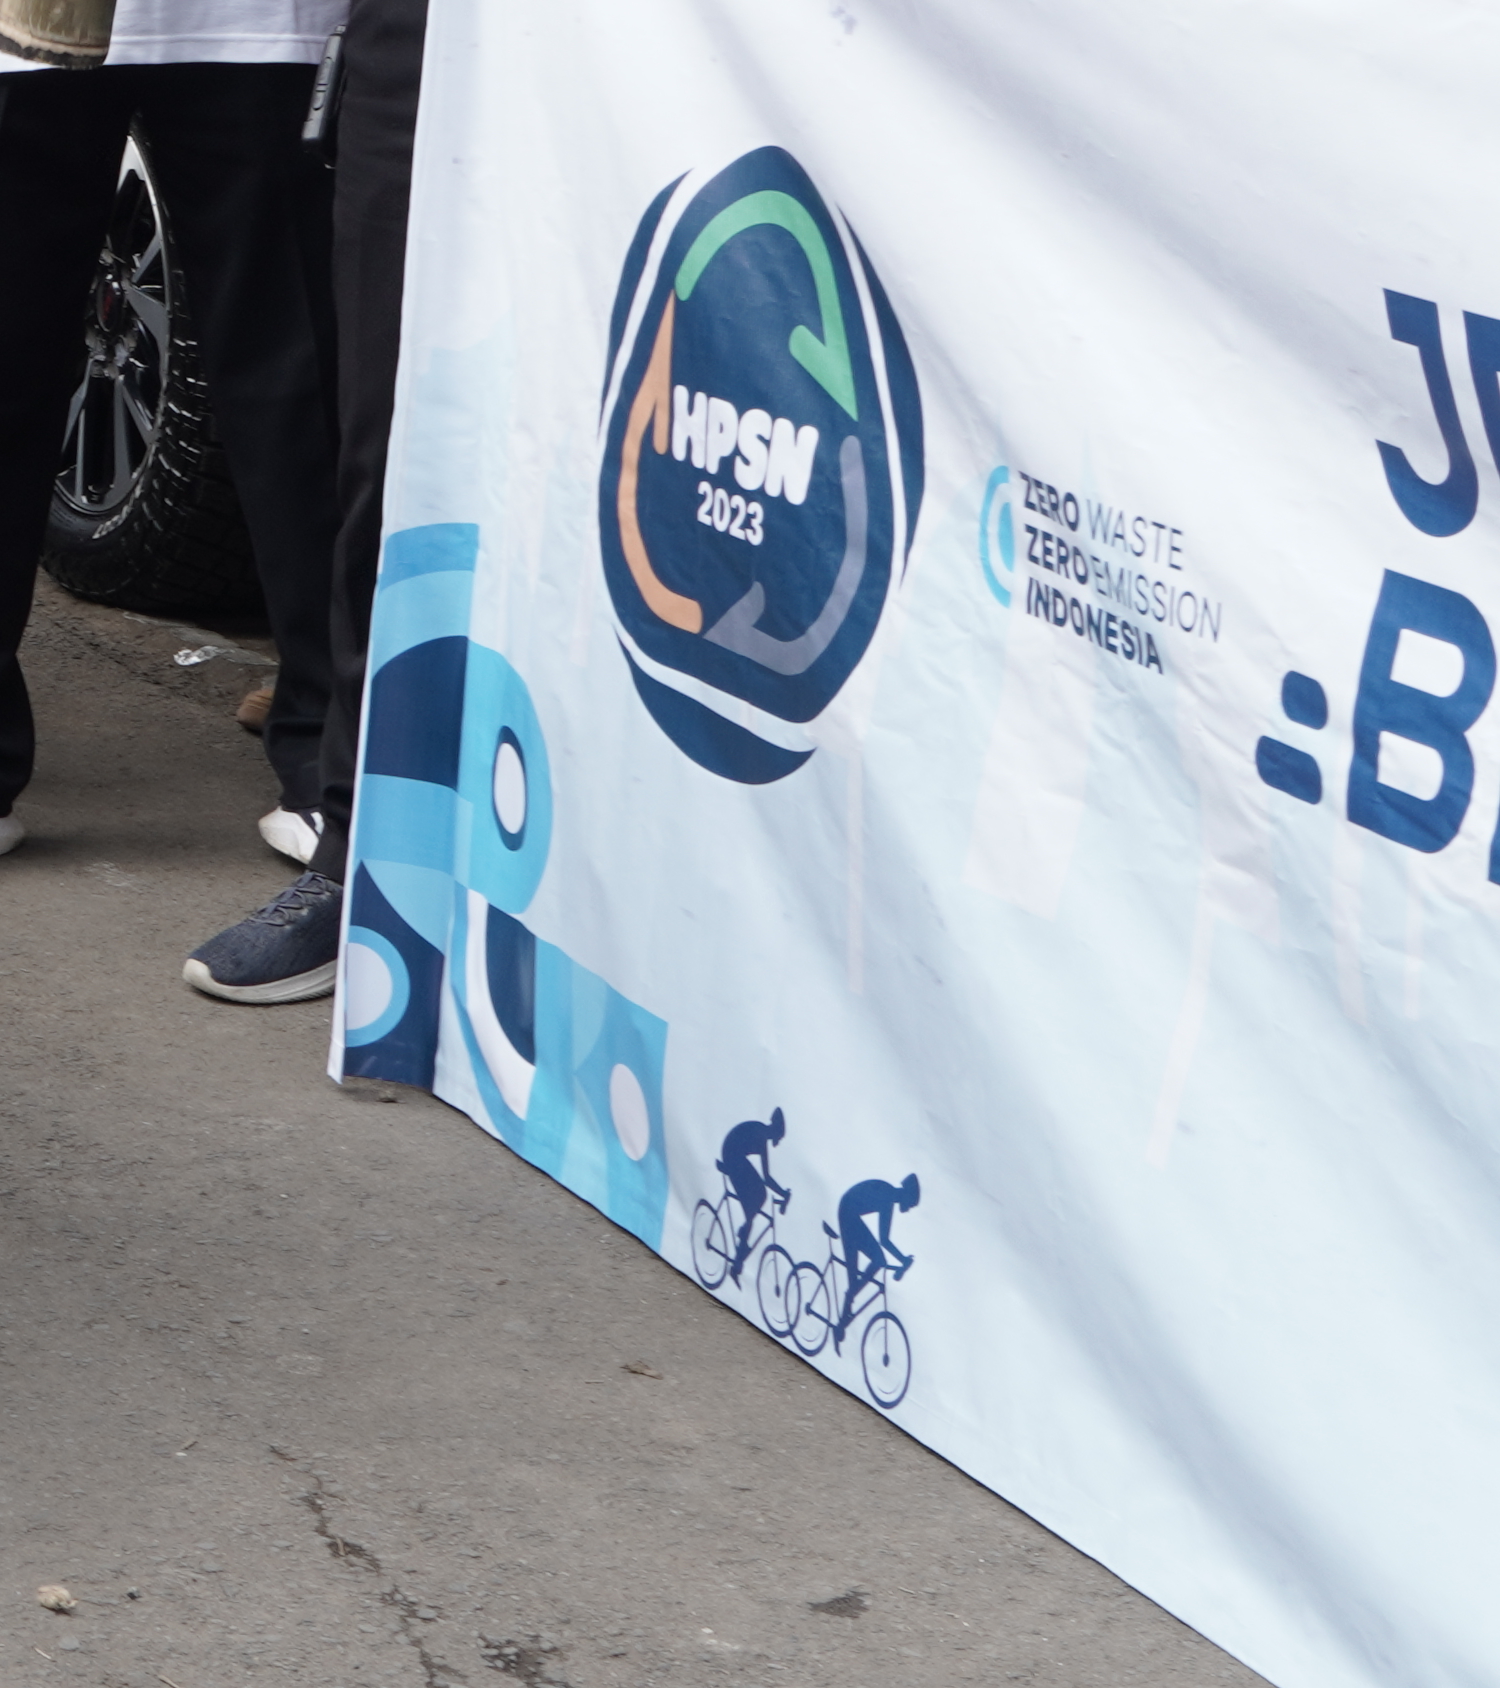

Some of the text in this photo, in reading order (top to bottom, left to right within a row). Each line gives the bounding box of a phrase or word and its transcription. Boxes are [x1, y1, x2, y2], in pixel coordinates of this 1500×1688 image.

[673, 385, 818, 505] HPSN
[697, 480, 764, 545] 2023
[1021, 471, 1185, 572] ZERO WASTE
[1025, 520, 1222, 642] ZERO EMISSION
[1025, 581, 1164, 675] INDONESIA
